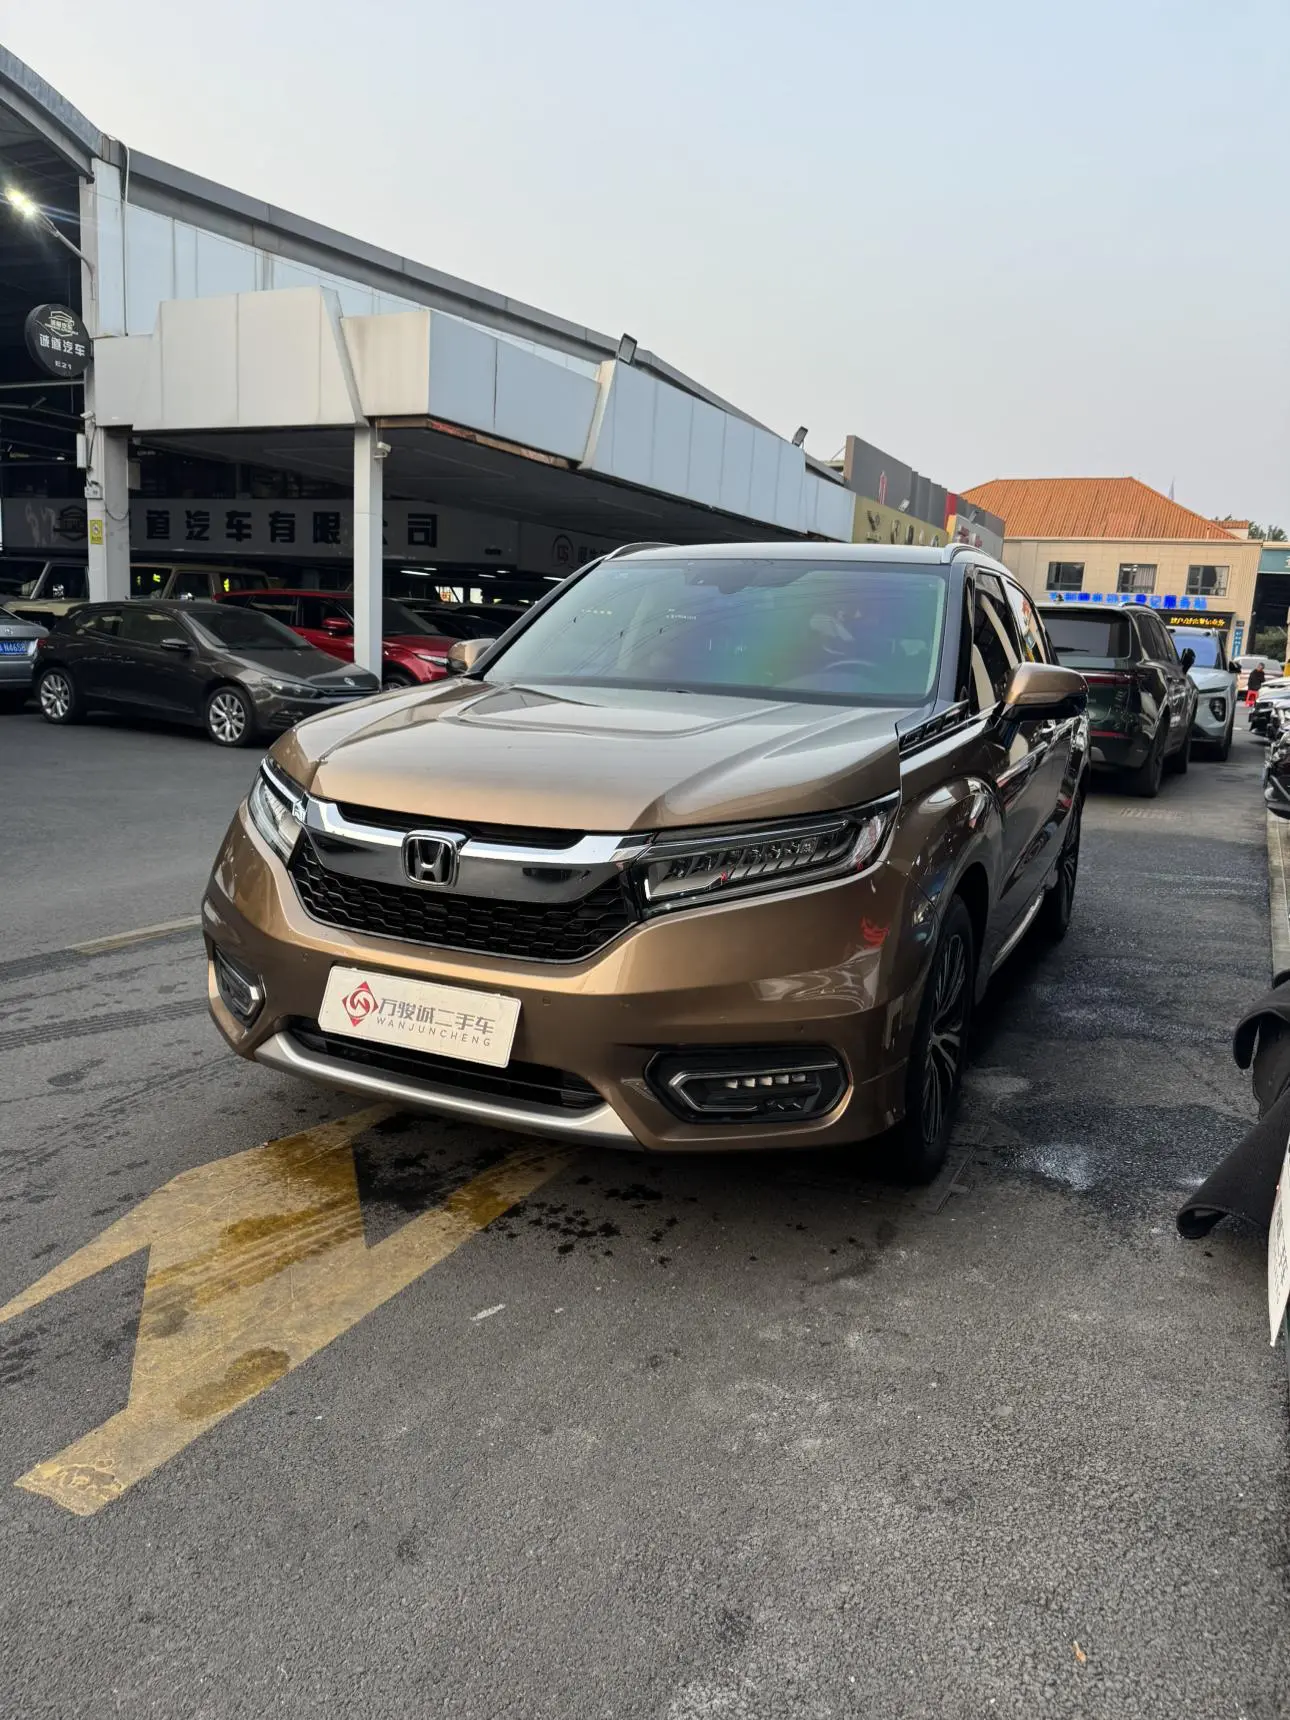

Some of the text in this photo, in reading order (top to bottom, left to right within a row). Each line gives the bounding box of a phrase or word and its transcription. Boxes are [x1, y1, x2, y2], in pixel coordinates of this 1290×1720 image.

[376, 1016, 492, 1047] WANJUNCHENG
[379, 998, 495, 1035] 万骏诚二手车
